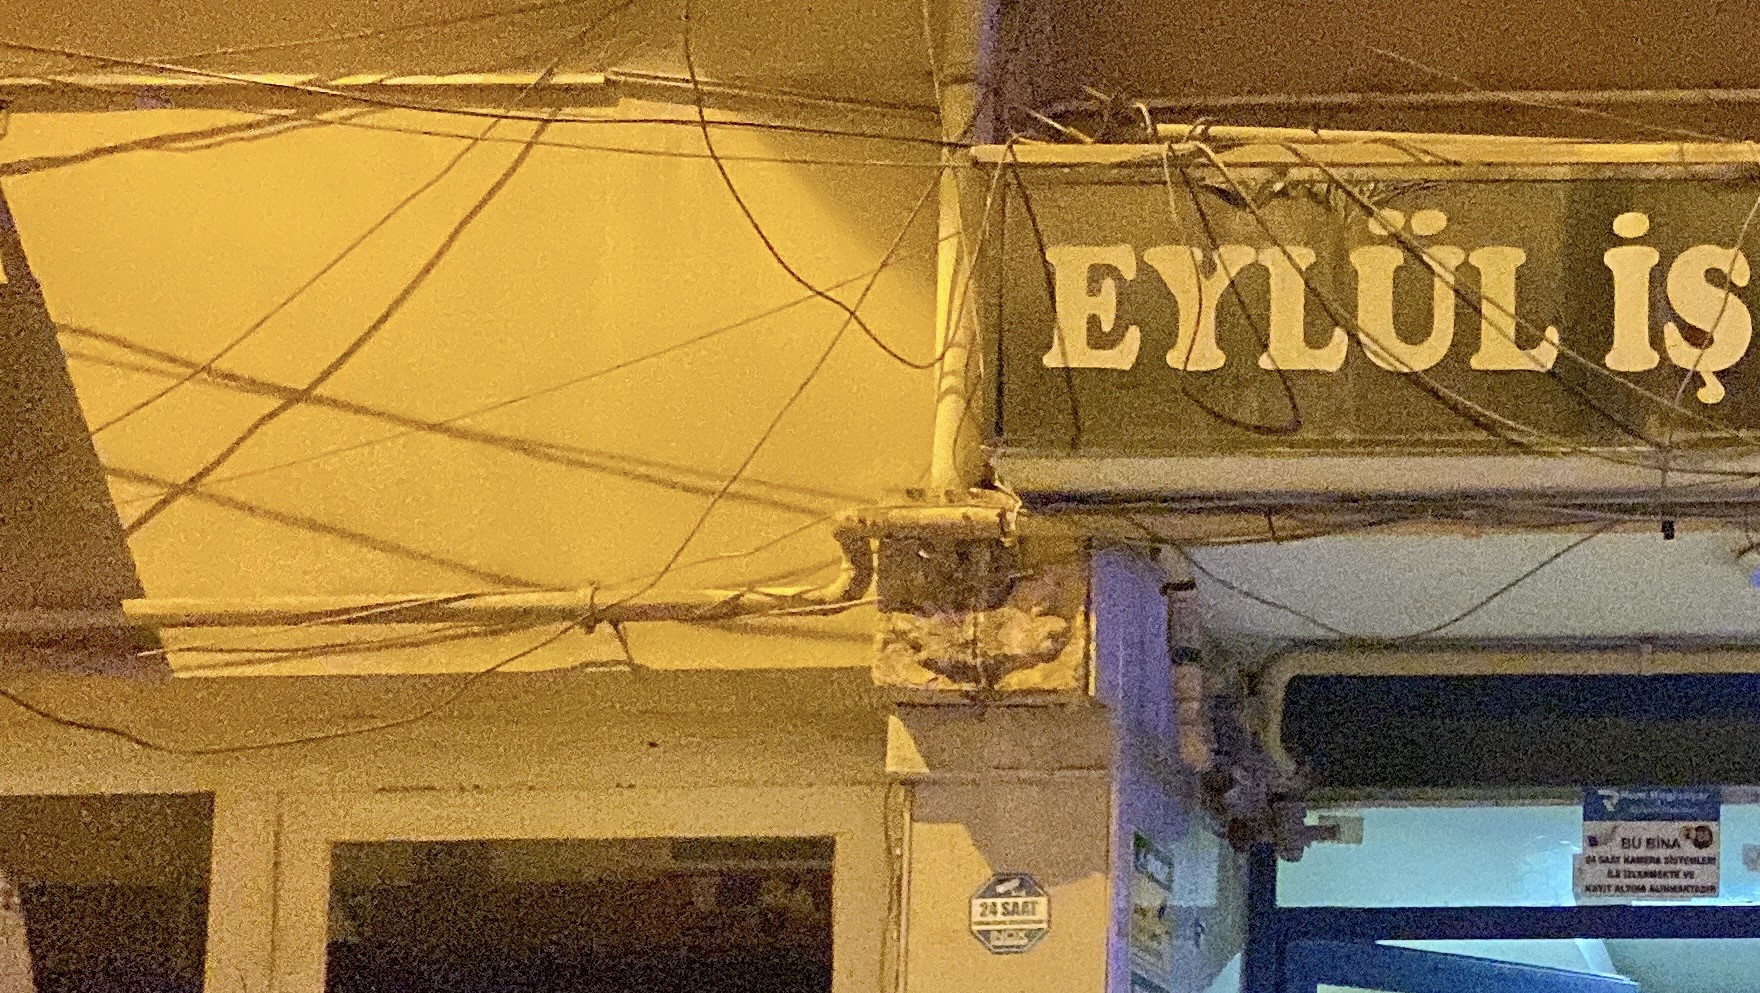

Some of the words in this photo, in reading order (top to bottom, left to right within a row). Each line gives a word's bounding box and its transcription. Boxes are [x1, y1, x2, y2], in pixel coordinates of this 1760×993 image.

[1043, 208, 1560, 373] EYLÜL
[1603, 211, 1753, 404] İŞ
[1620, 837, 1642, 850] BU
[1646, 835, 1682, 850] BİNA
[979, 901, 998, 917] 24
[1001, 901, 1038, 917] SAAT
